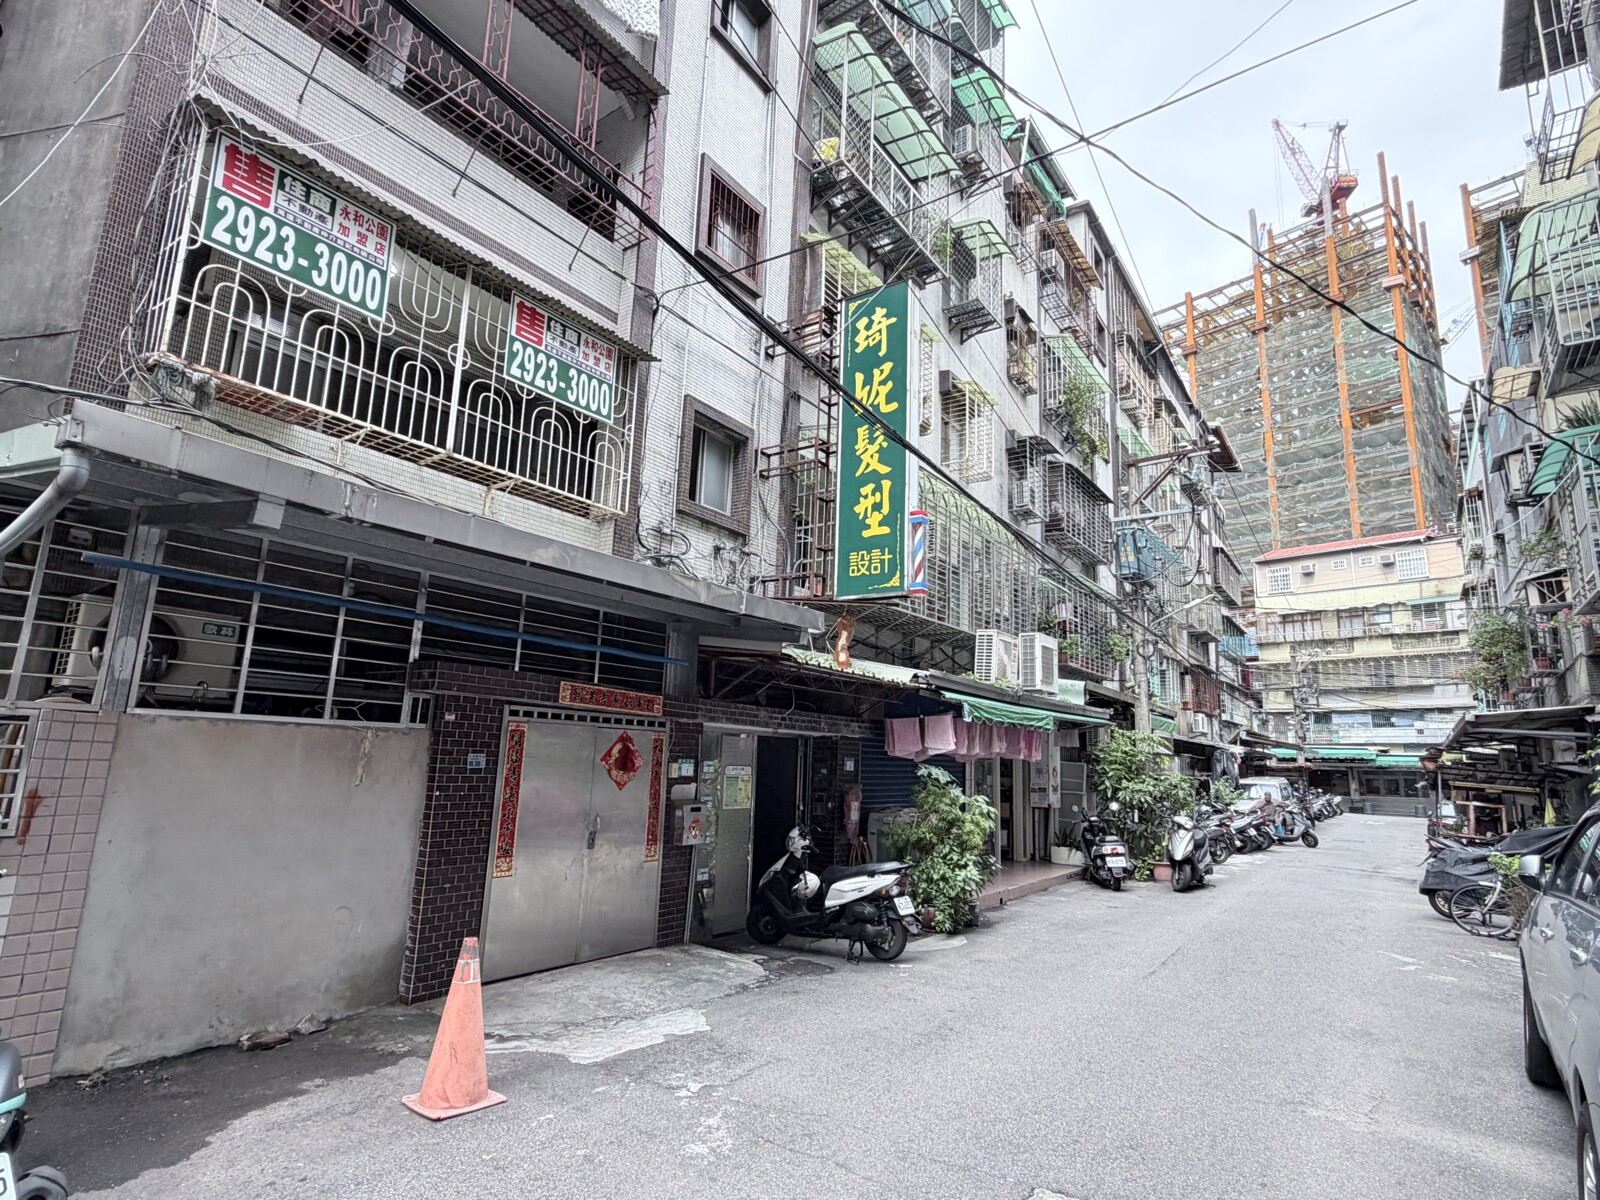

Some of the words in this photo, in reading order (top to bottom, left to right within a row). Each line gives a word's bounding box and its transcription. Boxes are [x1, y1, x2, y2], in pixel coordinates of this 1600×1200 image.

[222, 143, 276, 209] 售
[283, 175, 332, 214] 住商
[281, 193, 330, 227] 不動產
[339, 203, 389, 243] 永和公園
[211, 195, 382, 310] 2923-3000
[337, 221, 387, 257] 加盟店
[514, 300, 546, 348] 售
[549, 319, 579, 345] 住商
[582, 336, 614, 362] 永和公園
[510, 340, 610, 416] 2923-3000
[848, 547, 893, 578] 設計
